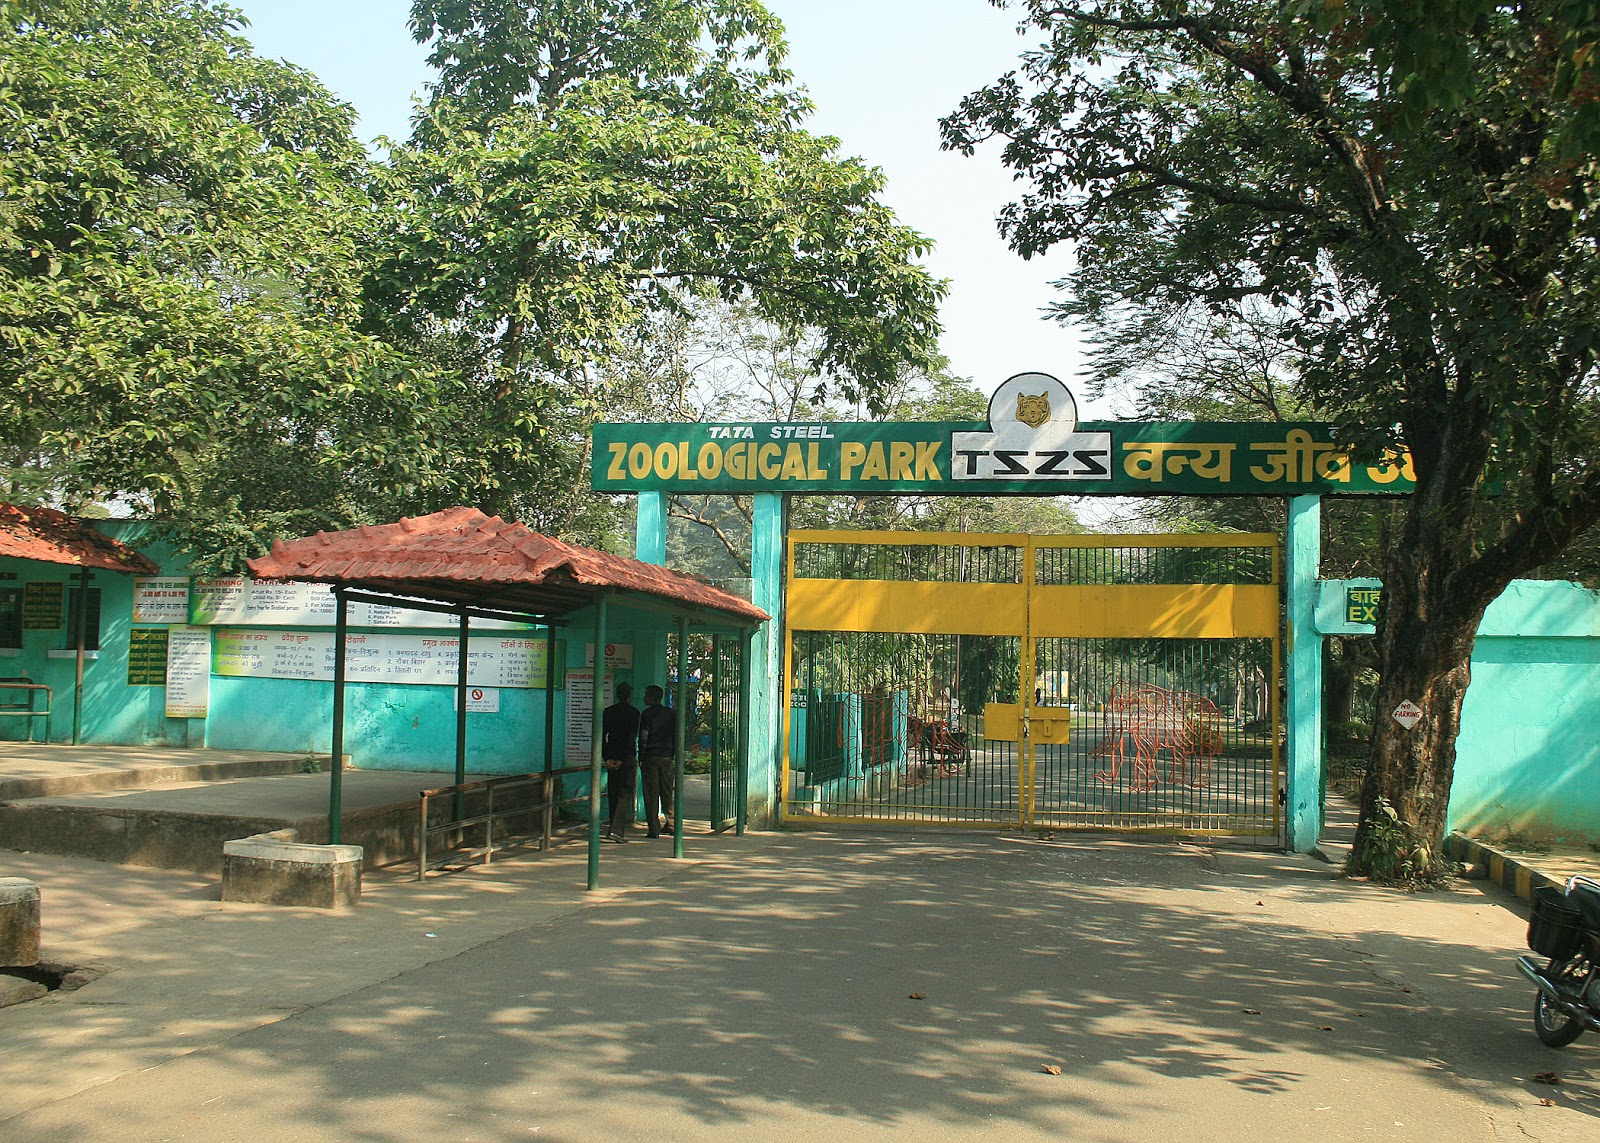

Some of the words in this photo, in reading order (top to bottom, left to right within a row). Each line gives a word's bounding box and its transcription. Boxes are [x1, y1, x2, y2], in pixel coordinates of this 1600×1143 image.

[709, 426, 754, 439] TATA
[770, 426, 834, 438] STEEL
[607, 442, 828, 480] ZOOLOGICAL
[840, 442, 942, 480] PARK
[1122, 442, 1236, 483] वन्य
[1349, 590, 1381, 605] बाह
[1349, 606, 1377, 621] EX
